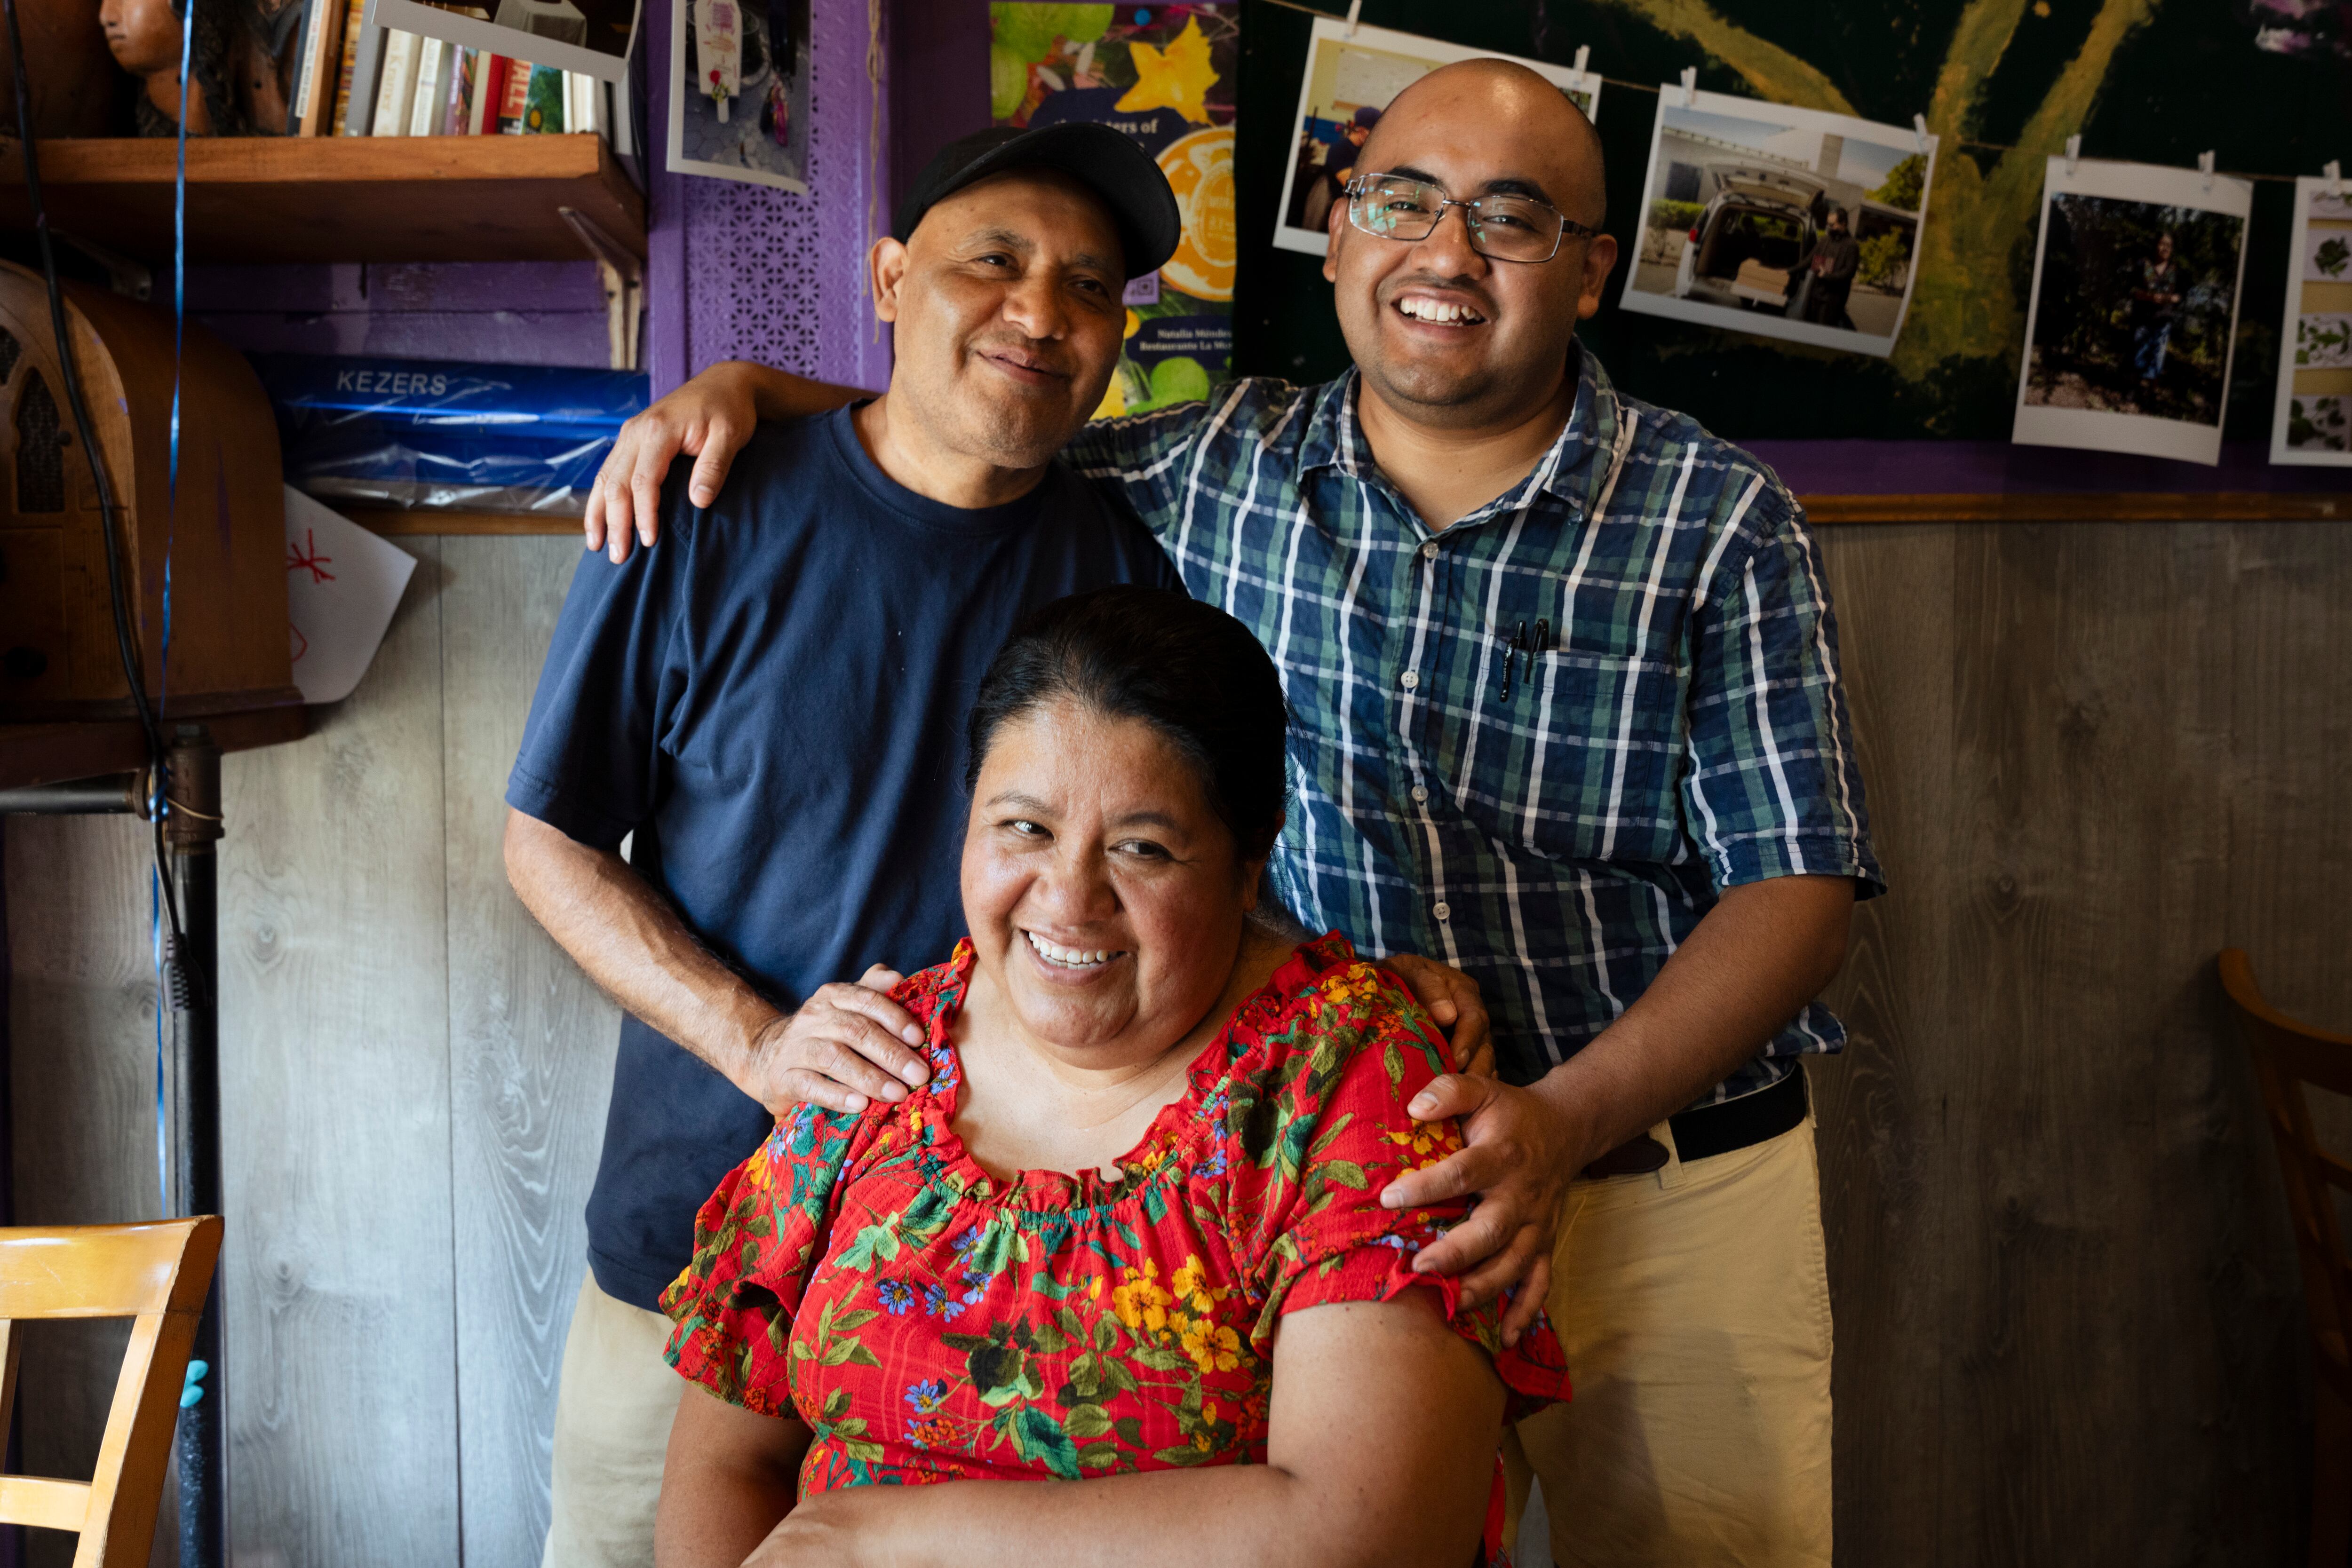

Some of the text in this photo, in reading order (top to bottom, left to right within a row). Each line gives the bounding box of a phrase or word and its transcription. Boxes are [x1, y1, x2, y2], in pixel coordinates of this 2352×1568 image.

[1140, 118, 1159, 134] of
[1200, 341, 1212, 351] La
[336, 370, 447, 396] KEZERS
